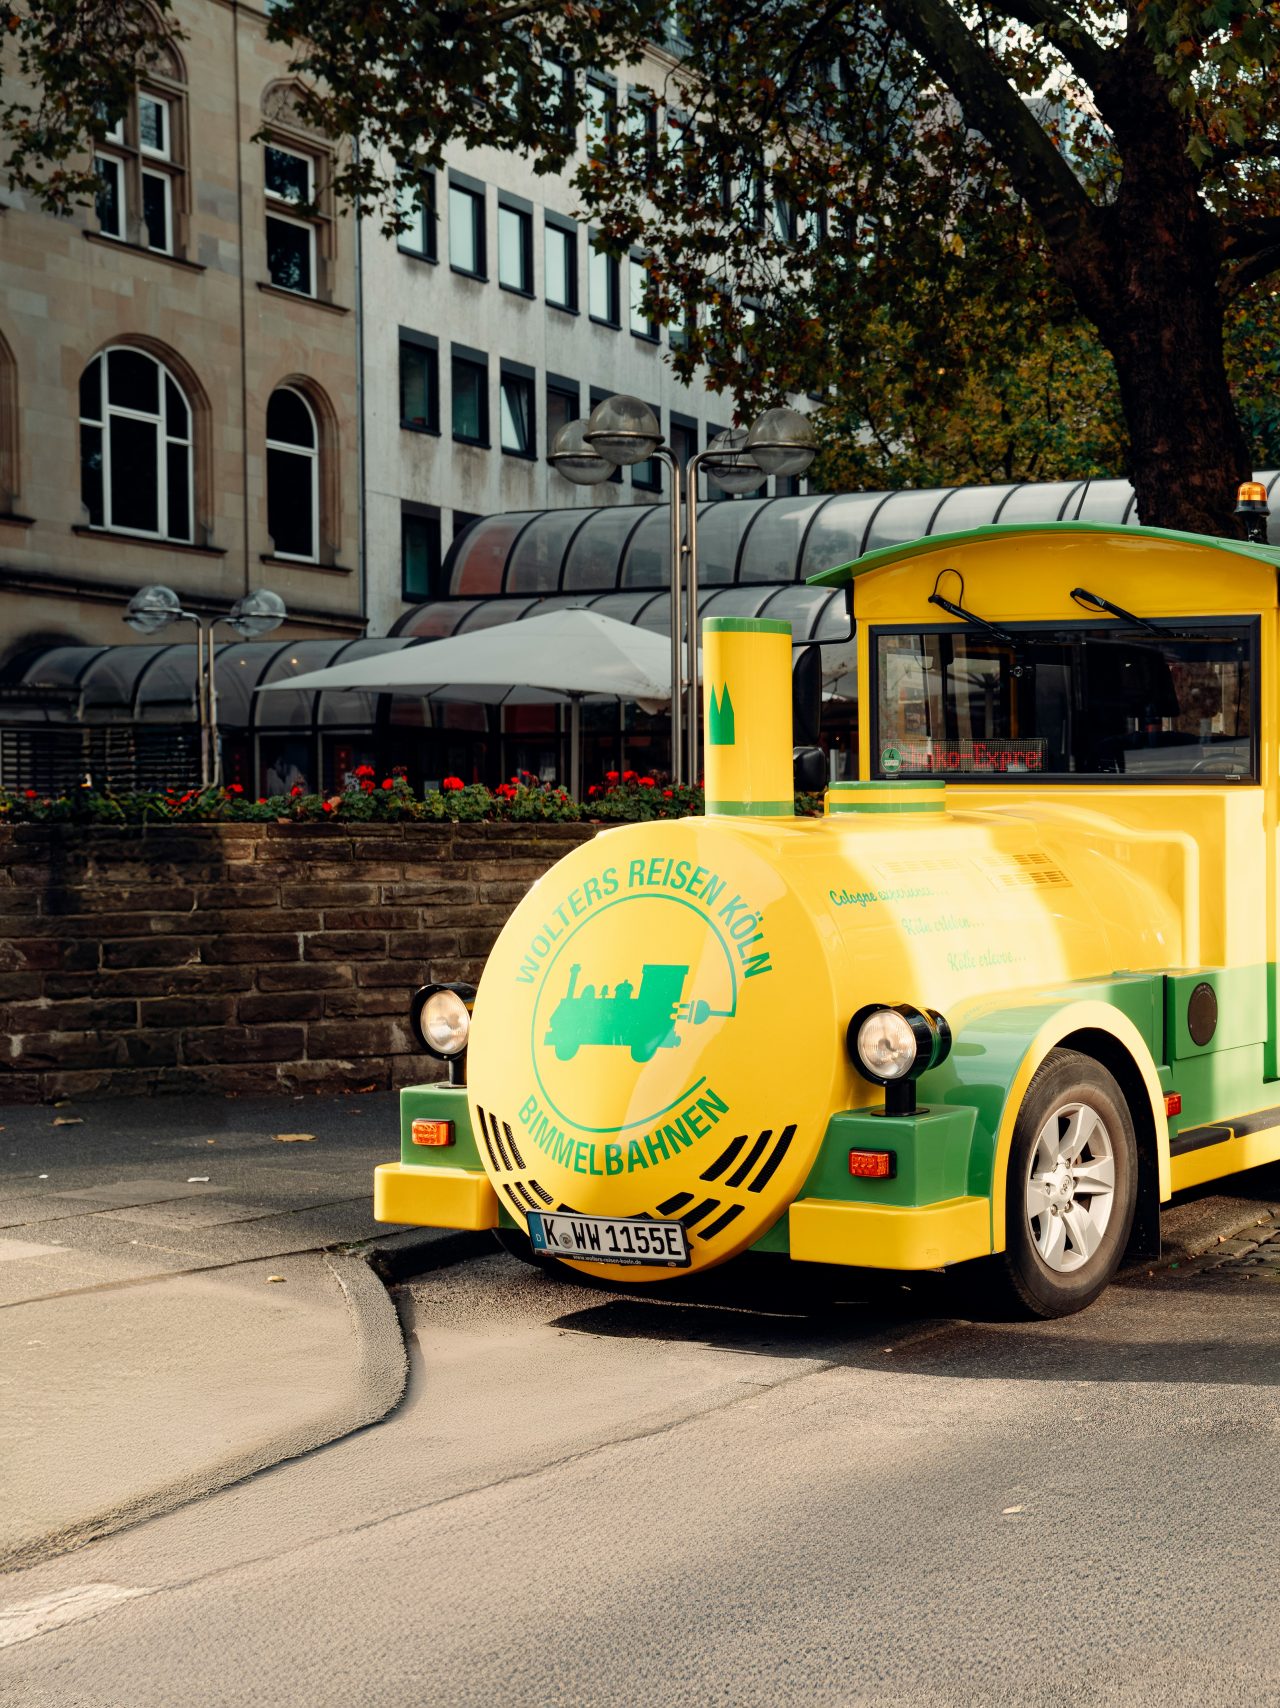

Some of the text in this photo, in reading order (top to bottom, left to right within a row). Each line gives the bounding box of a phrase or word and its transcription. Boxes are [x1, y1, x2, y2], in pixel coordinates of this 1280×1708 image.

[829, 889, 877, 907] Cologne
[515, 857, 773, 985] WOLTERS REISEN KÖLN
[518, 1088, 730, 1176] BIMMELBAHNEN
[543, 1218, 682, 1256] K WW 1155E
[573, 1255, 641, 1265] www.wolters-reisen-koeln.de
